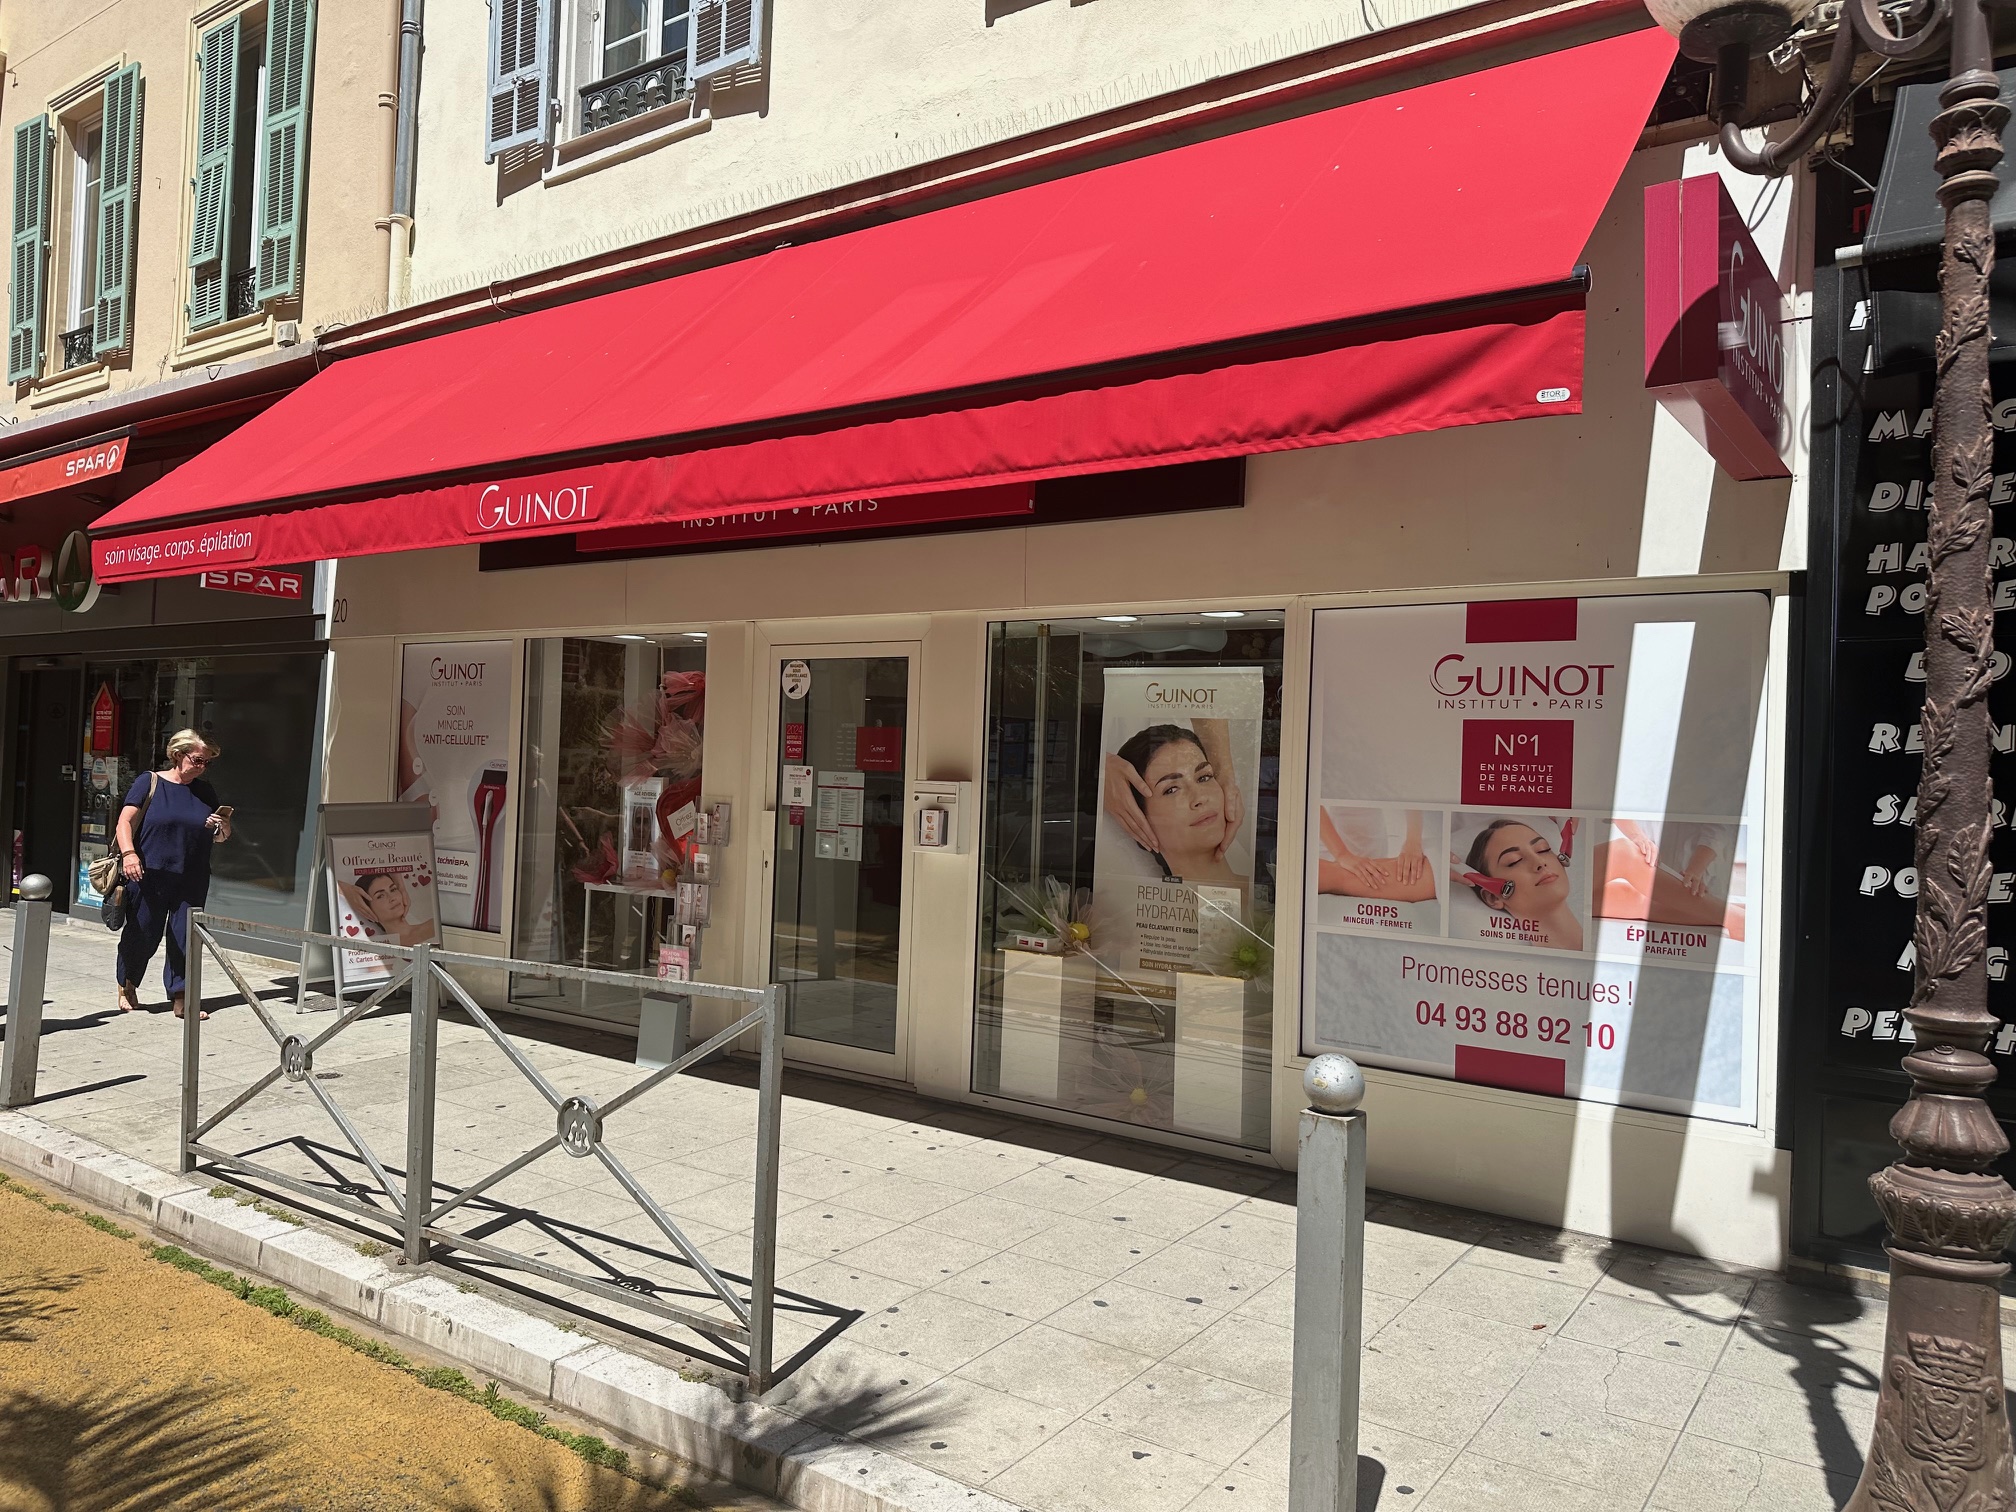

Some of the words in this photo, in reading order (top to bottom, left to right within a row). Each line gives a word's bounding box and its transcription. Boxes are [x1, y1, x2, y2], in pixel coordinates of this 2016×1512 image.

[65, 452, 106, 477] SPAR
[476, 484, 594, 529] GUINOT
[812, 499, 878, 517] PARIS
[105, 546, 125, 565] soin
[164, 541, 195, 560] corps
[208, 570, 299, 594] SPAR
[333, 598, 348, 623] 20
[430, 657, 486, 680] GUINOT
[1429, 653, 1615, 697] GUINOT
[1145, 682, 1218, 704] GUINOT
[446, 705, 466, 716] SOIN
[1436, 699, 1522, 710] INSTITUT
[1549, 699, 1604, 710] PARIS
[437, 720, 474, 731] MINCEUR
[1479, 763, 1495, 771] EN
[1499, 763, 1554, 773] INSTITUT
[1479, 773, 1496, 782] DE
[1501, 772, 1554, 784] BEAUTÉ
[1479, 783, 1496, 793] EN
[1501, 784, 1554, 794] FRANCE
[367, 840, 397, 849] GUINOT
[342, 855, 376, 866] Offrez
[388, 852, 423, 863] Beauté
[1137, 885, 1199, 904] REPULPAN
[1136, 903, 1199, 923] HYDRATAN
[1356, 903, 1399, 919] CORPS
[1148, 922, 1175, 932] ÉCLATANTE
[1342, 915, 1374, 925] MINCEUR
[1381, 918, 1413, 930] FERMETÉ
[1489, 916, 1540, 932] VISAGE
[1480, 929, 1501, 939] SOINS
[1503, 931, 1516, 941] DE
[1518, 932, 1549, 943] BEAUTÉ
[1626, 925, 1707, 948] ÉPILATION
[1645, 945, 1687, 957] PARFAITE
[1402, 956, 1527, 994] Promesses
[1537, 970, 1620, 1005] tenues
[1627, 980, 1634, 1006] !
[1415, 1000, 1447, 1028] 04
[1455, 1005, 1487, 1033] 93
[1496, 1010, 1528, 1038] 88
[1537, 1016, 1571, 1045] 92
[1582, 1021, 1615, 1051] 10
